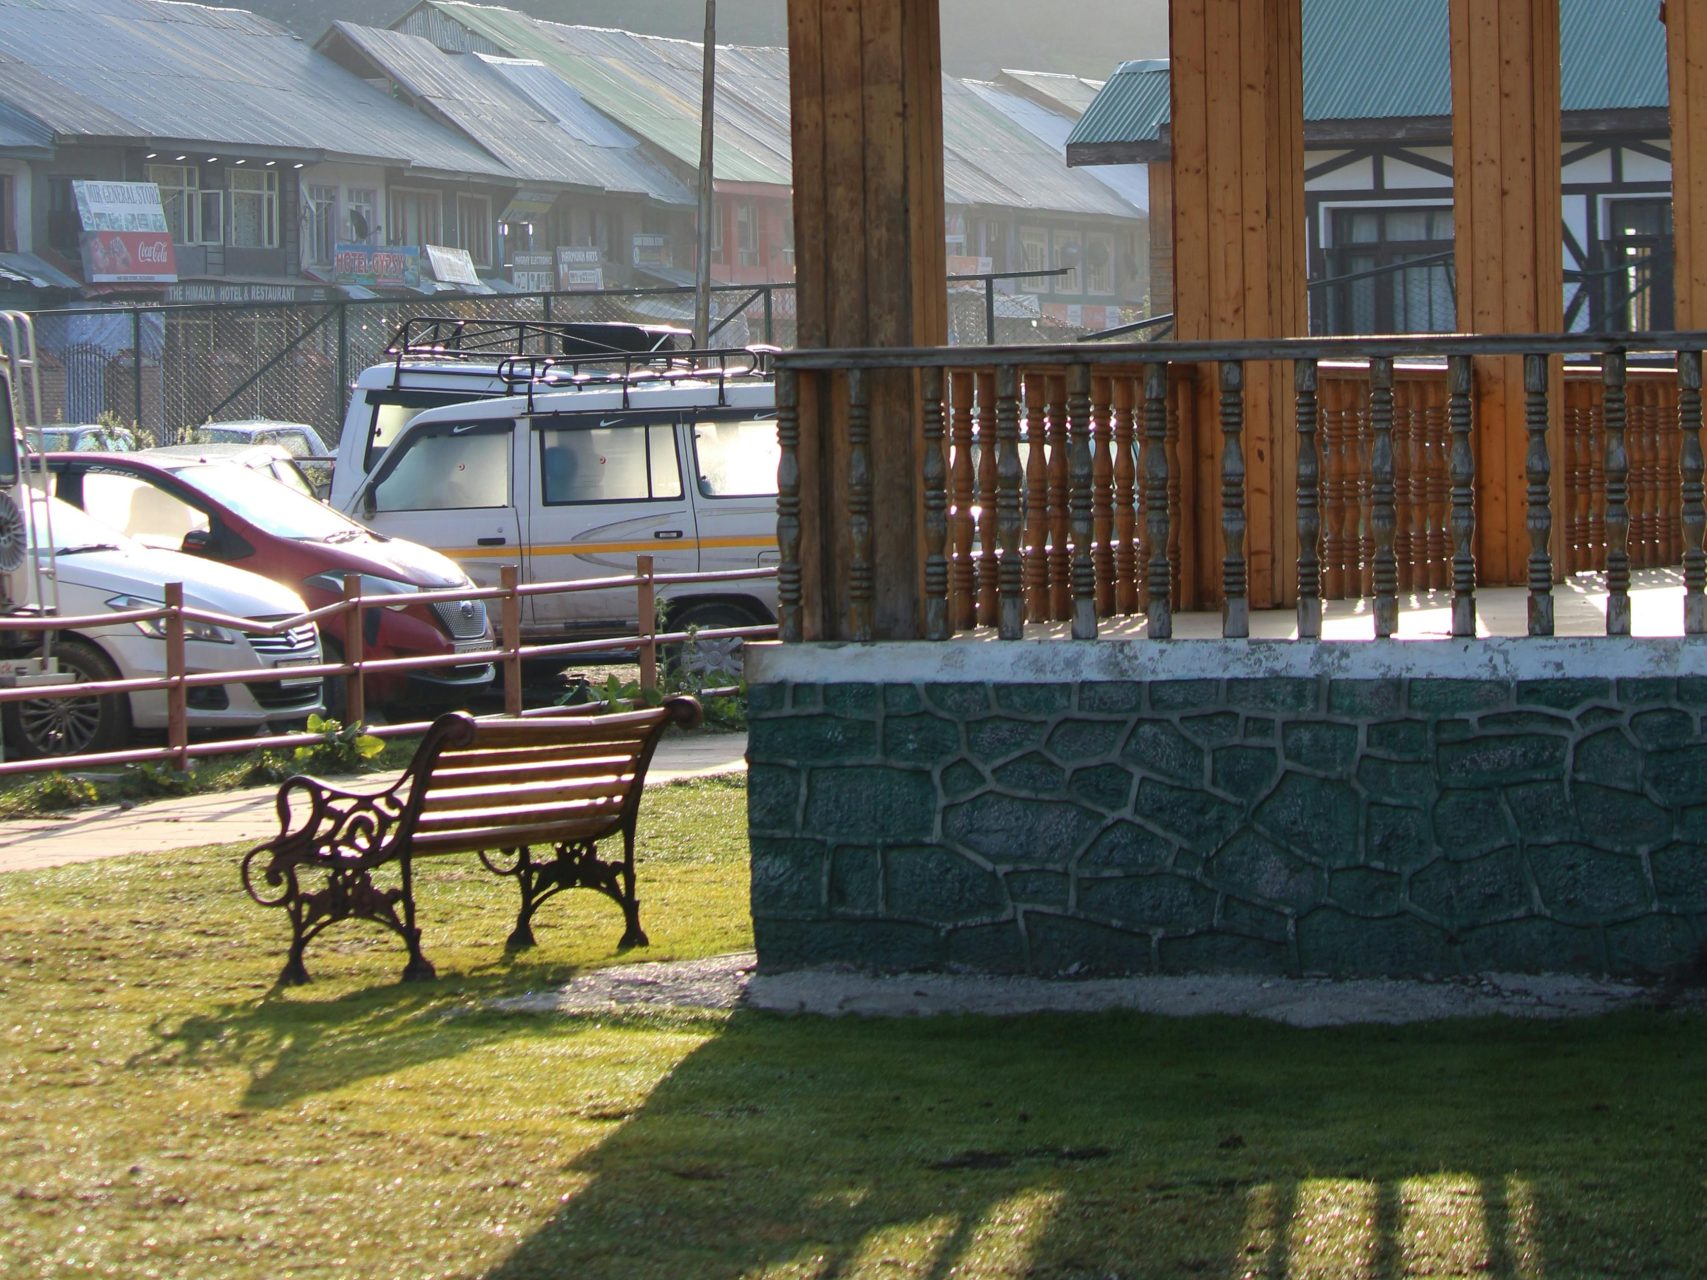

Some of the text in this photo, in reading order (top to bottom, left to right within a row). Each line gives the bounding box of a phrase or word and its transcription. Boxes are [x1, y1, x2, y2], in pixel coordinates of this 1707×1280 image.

[86, 184, 161, 204] MIR GENERAL STORE
[336, 251, 405, 274] HOTEL GYPSY
[168, 286, 183, 301] THE
[185, 286, 216, 301] HIMALYA
[219, 286, 242, 301] HOTEL
[243, 287, 250, 300] &
[251, 286, 296, 301] RESTAURANT
